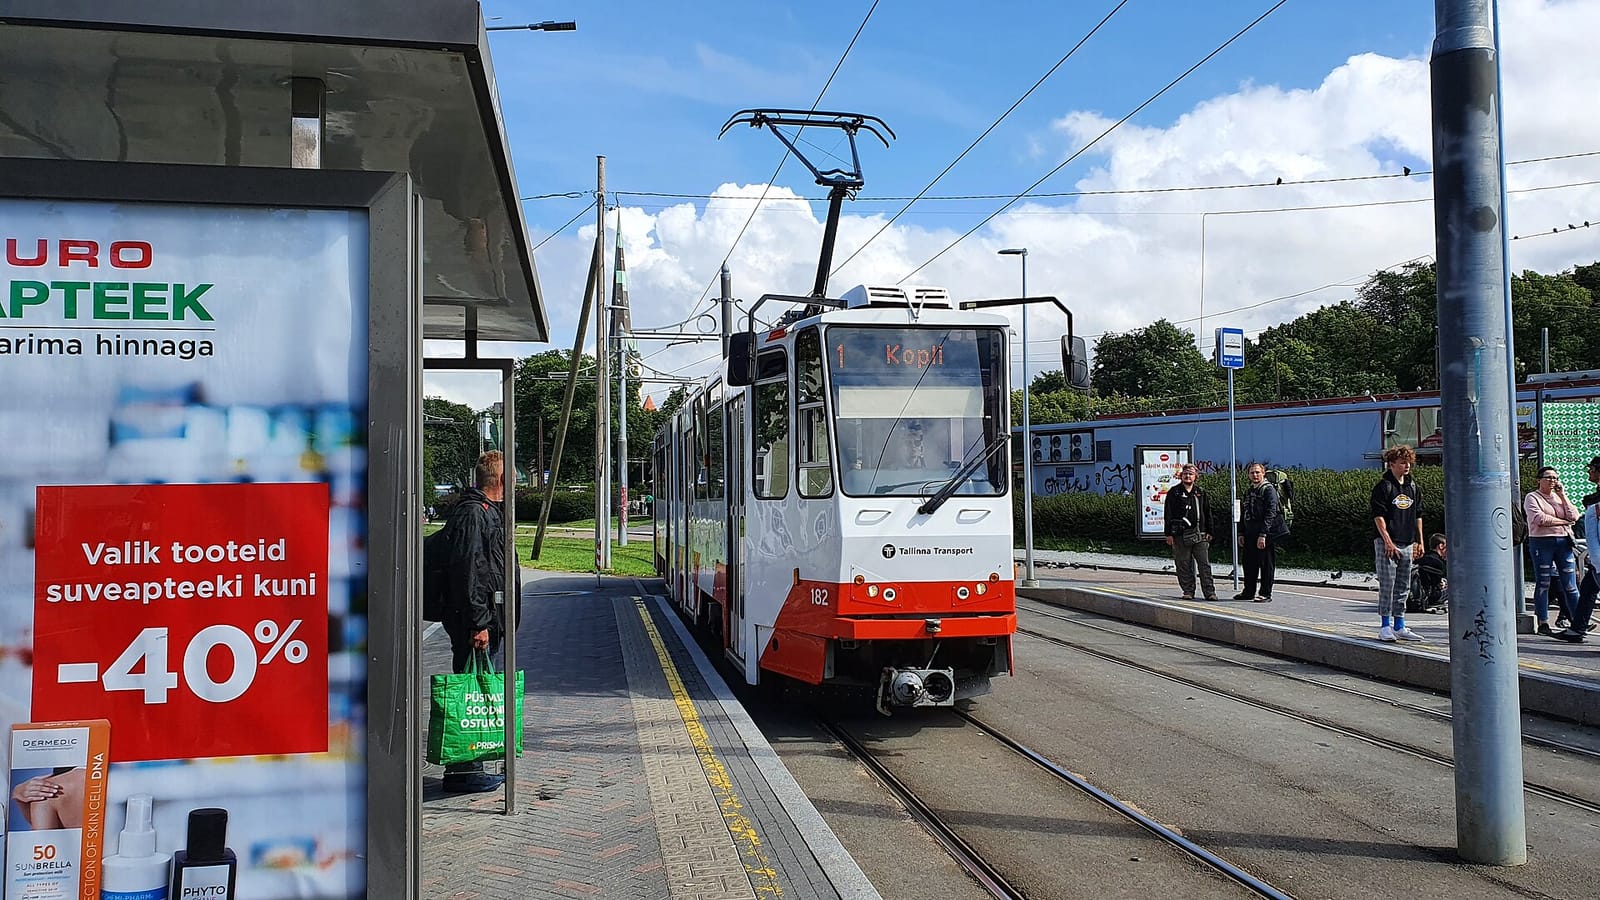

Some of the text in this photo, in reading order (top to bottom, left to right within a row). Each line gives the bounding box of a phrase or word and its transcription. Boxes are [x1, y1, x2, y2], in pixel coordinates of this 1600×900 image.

[6, 238, 154, 269] URO
[0, 280, 215, 321] PTEEK
[96, 333, 214, 360] hinnaga
[836, 344, 943, 368] 1 Kopli
[82, 539, 286, 565] Valik tooteid
[899, 547, 974, 556] Tallinna Transport
[46, 573, 316, 604] suveapteeki kuni
[810, 588, 828, 606] 182
[57, 619, 309, 705] -40%
[23, 739, 78, 747] DERMEDIC
[91, 753, 104, 780] DNA
[89, 782, 102, 810] CELL
[87, 812, 99, 839] SKIN
[33, 845, 56, 860] 50
[86, 840, 97, 858] OF
[15, 861, 72, 871] SUNBRELLA
[183, 886, 226, 897] PHYTO
